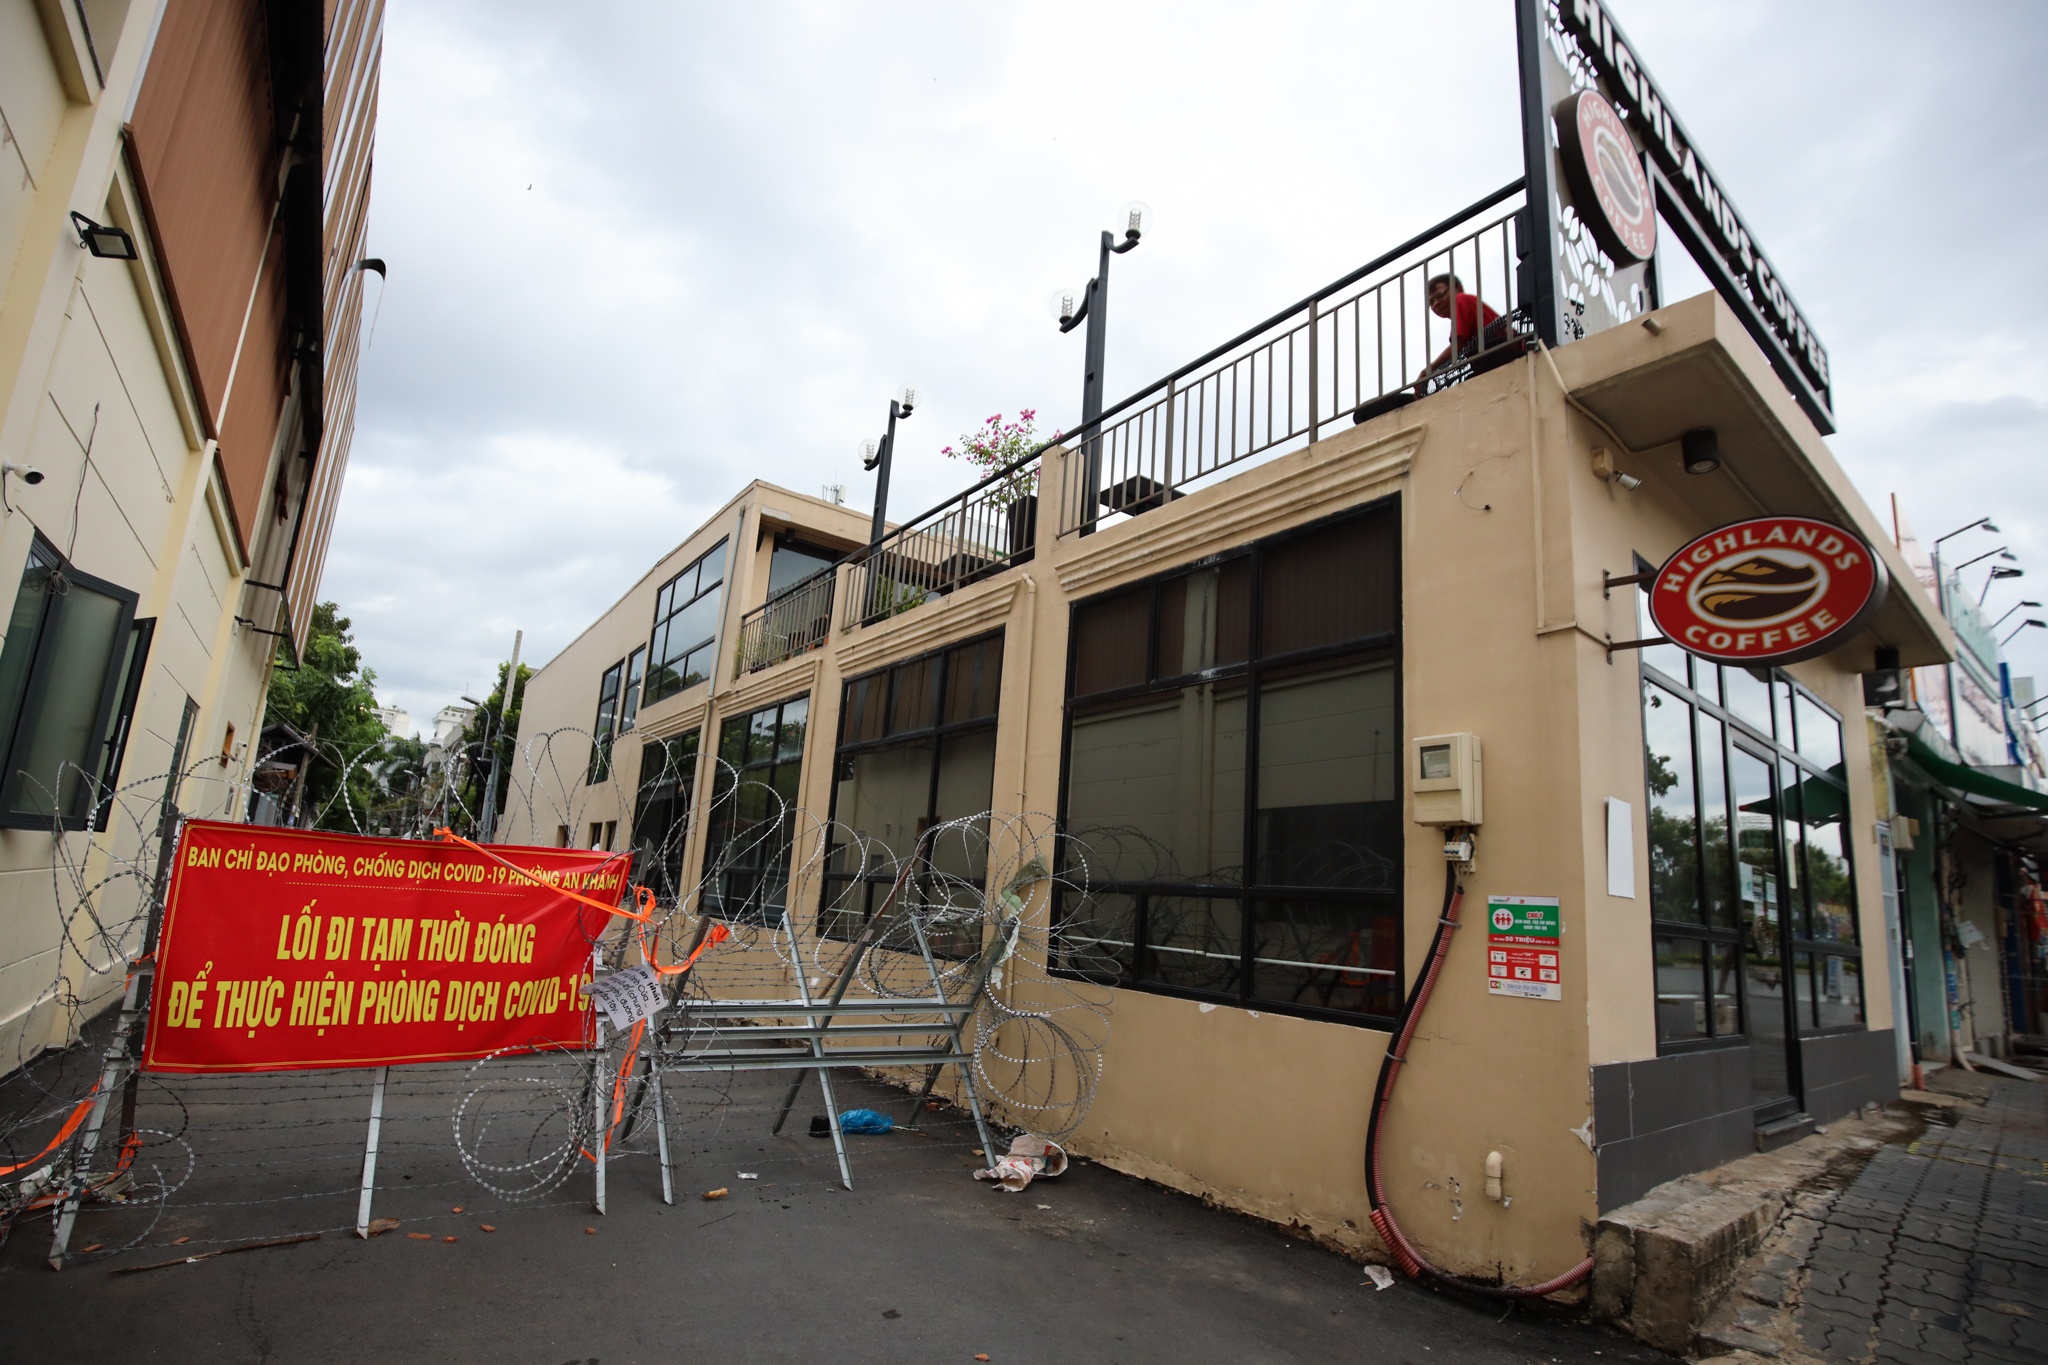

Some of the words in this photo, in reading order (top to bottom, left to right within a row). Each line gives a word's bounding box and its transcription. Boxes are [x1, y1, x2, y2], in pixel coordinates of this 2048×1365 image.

[1573, 0, 1754, 271] HIGHLANDS
[1755, 258, 1830, 386] COFFEE
[1594, 174, 1647, 250] COFFEE
[1662, 525, 1861, 593] HIGHLANDS
[1684, 608, 1838, 651] COFFEE
[187, 846, 221, 868] BAN
[224, 843, 255, 870] CHỈ
[256, 851, 290, 877] ĐẠO
[293, 849, 348, 879] PHÒNG,
[353, 851, 405, 879] CHỐNG
[408, 861, 440, 885] DỊCH
[444, 862, 486, 883] COVID
[562, 872, 580, 889] AN
[582, 870, 620, 891] KHÁNH
[276, 899, 322, 960] LỐI
[325, 916, 355, 961] ĐI
[360, 917, 413, 971] TẠM
[417, 910, 471, 962] THỜI
[472, 914, 537, 964] ĐÓNG
[167, 960, 213, 1029] ĐỂ
[213, 976, 285, 1038] THỰC
[289, 971, 354, 1036] HIỆN
[357, 969, 441, 1025] PHÒNG
[443, 980, 501, 1031] DỊCH
[503, 972, 592, 1020] COVID-19
